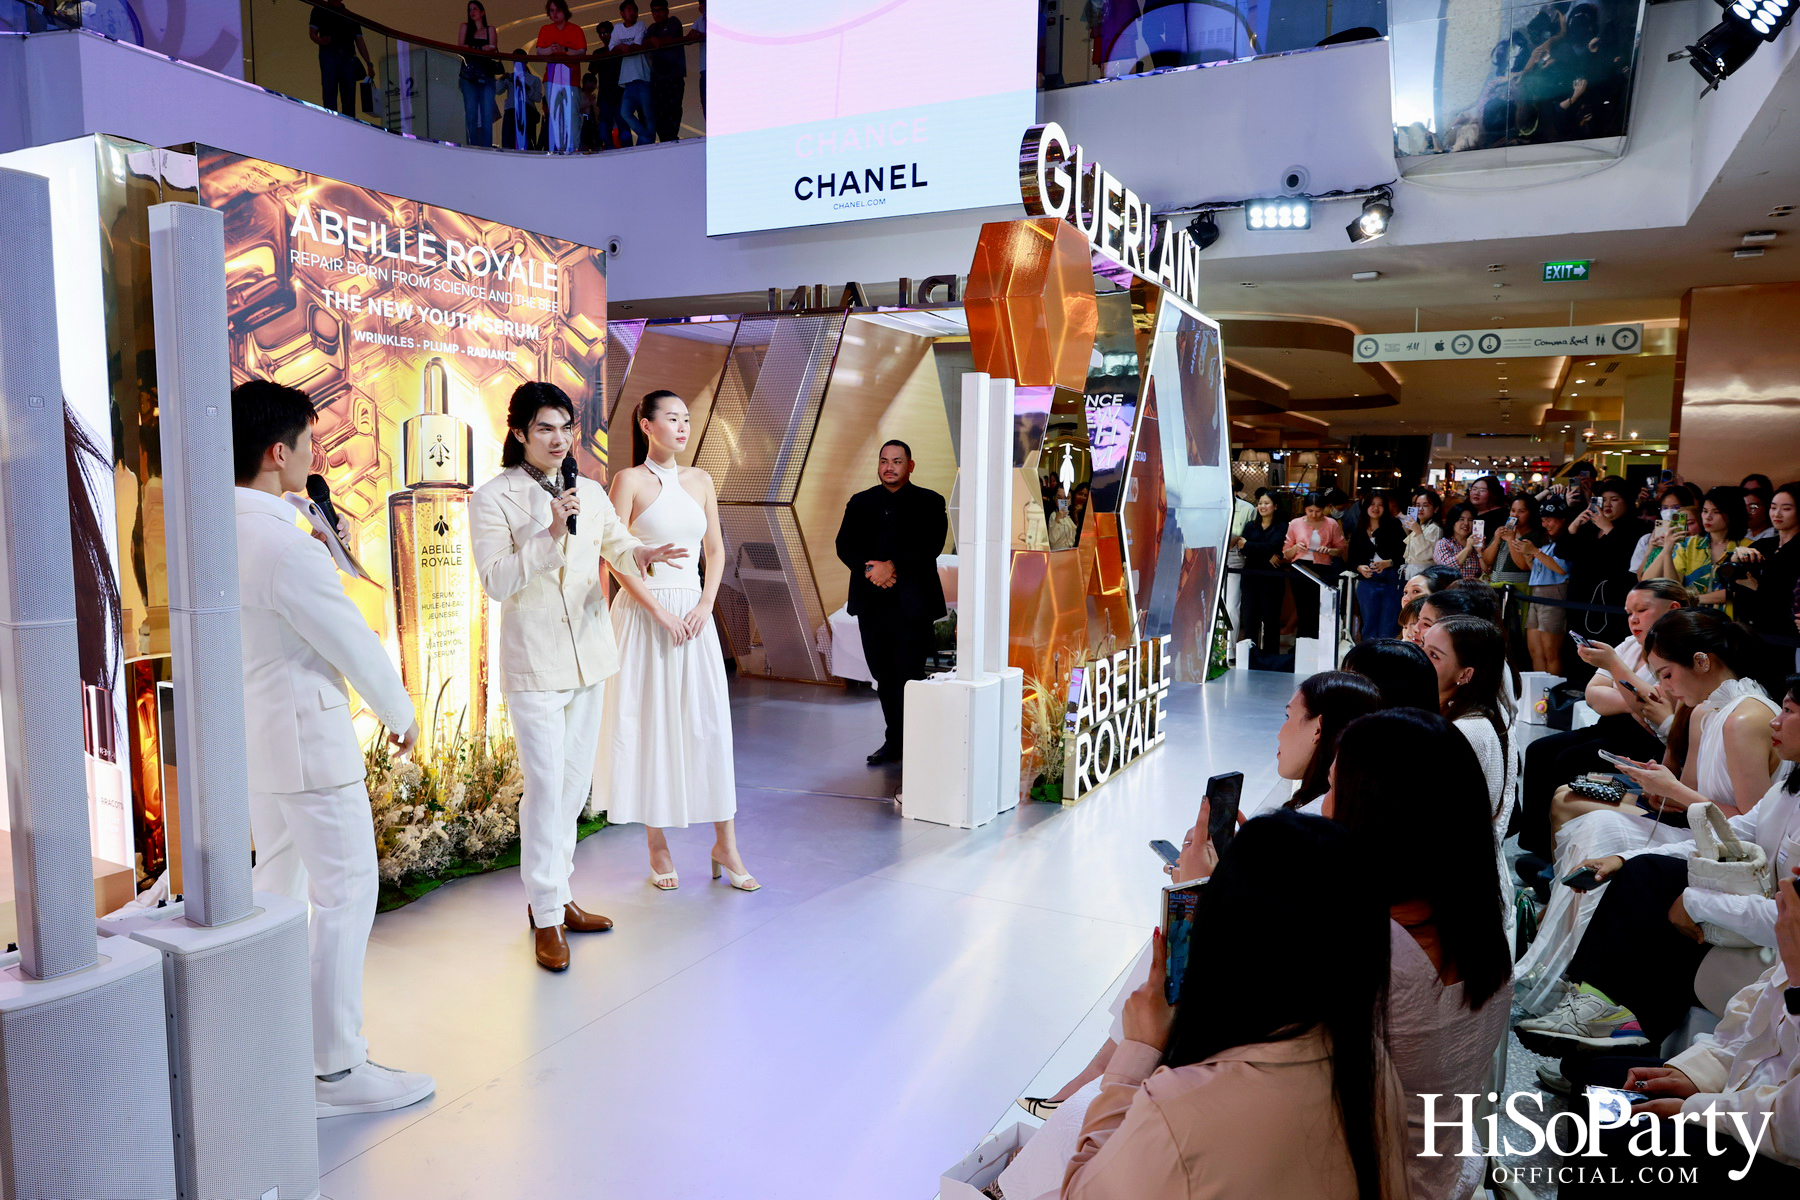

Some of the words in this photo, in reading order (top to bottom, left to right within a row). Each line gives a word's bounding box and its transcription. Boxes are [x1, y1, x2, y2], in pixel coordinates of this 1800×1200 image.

[795, 118, 928, 158] CHANCE
[794, 163, 928, 201] CHANEL
[833, 198, 886, 210] CHANEL.COM
[1037, 121, 1200, 307] GUERLAIN
[290, 204, 437, 266] ABEILLE
[446, 239, 558, 292] ROYALE
[290, 249, 343, 272] REPAIR
[347, 261, 388, 281] BORN
[392, 270, 430, 289] FROM
[433, 278, 486, 300] SCIENCE
[488, 289, 513, 304] AND
[515, 294, 538, 309] THE
[538, 298, 558, 313] BEE
[1545, 264, 1574, 279] EXIT
[321, 289, 362, 313] THE
[368, 297, 414, 320] NEW
[417, 305, 480, 332] YOUTH
[482, 317, 540, 340] SERUM
[353, 330, 415, 349] WRINKLES
[423, 340, 460, 354] PLUMP
[467, 346, 517, 362] RADIANCE
[1534, 338, 1568, 346] Comma
[421, 544, 462, 556] ABEILLE
[421, 556, 462, 568] ROYALE
[421, 601, 464, 610] HUILE-EN-EAU
[428, 611, 459, 620] JEUNESSE
[433, 630, 455, 638] YOUTH
[1075, 634, 1171, 735] ABEILLE
[1074, 688, 1168, 801] ROYALE
